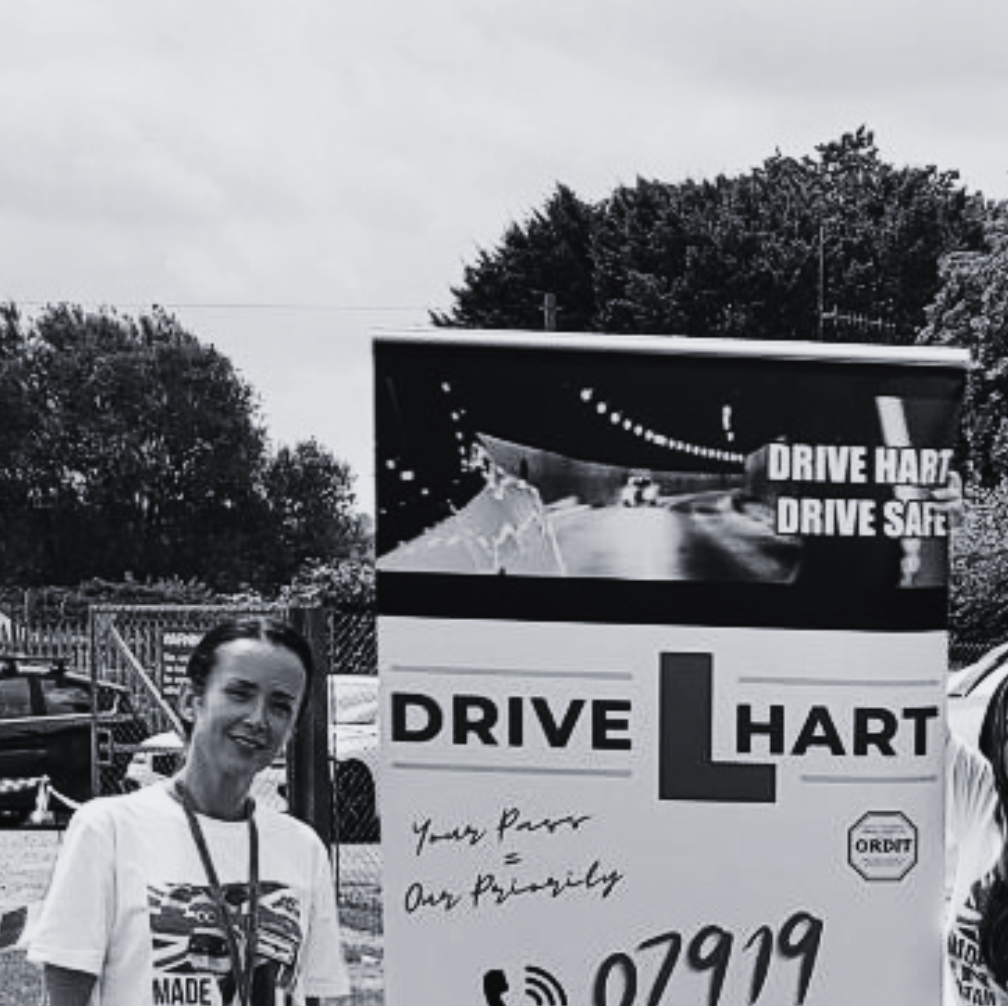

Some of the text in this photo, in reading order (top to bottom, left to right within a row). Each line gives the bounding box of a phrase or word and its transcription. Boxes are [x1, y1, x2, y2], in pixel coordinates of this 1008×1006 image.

[769, 443, 954, 484] DRIVE HART
[777, 498, 947, 538] DRIVE SAFE
[391, 651, 940, 804] DRIVE L HART
[412, 806, 592, 857] Your Pass
[855, 838, 914, 854] ORDIT
[404, 881, 463, 915] Our
[152, 977, 212, 1006] MADE
